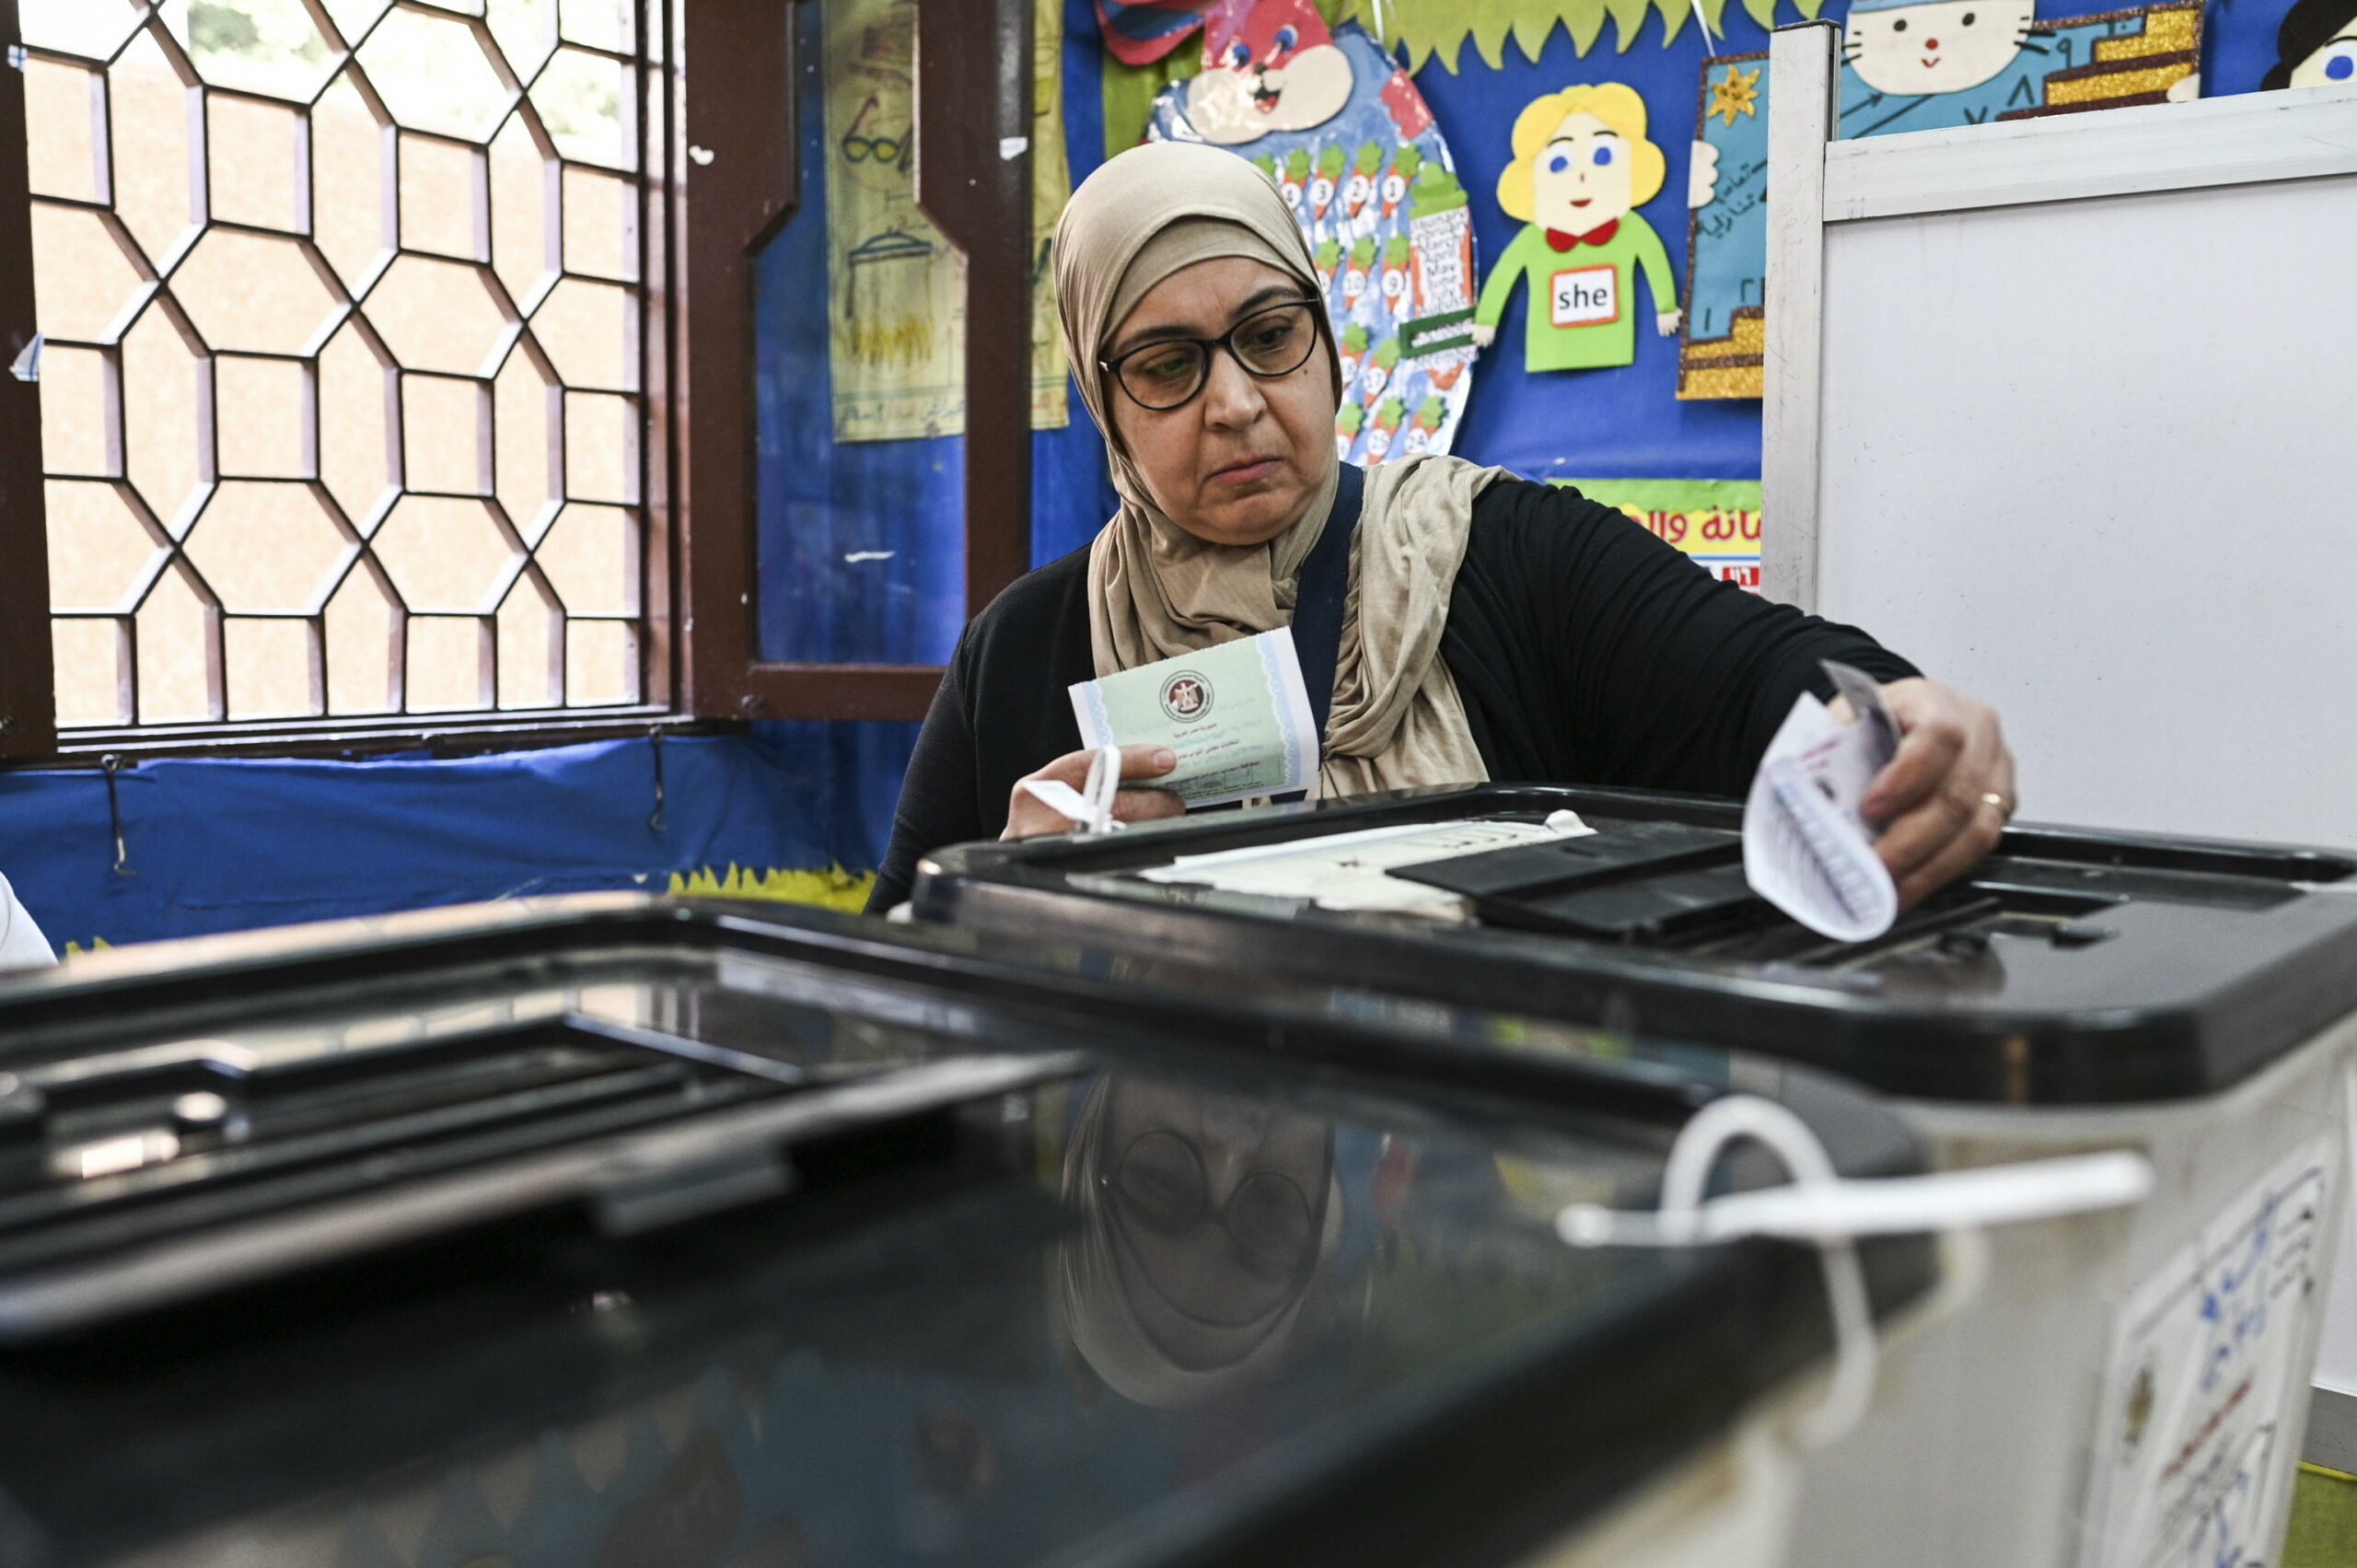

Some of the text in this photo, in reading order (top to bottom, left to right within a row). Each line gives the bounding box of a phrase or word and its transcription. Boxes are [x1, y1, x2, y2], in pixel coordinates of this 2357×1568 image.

[1318, 183, 1328, 200] 3
[1351, 180, 1363, 197] 2
[1388, 181, 1398, 198] 1
[1388, 276, 1399, 293] 9
[1559, 284, 1608, 310] she
[1629, 505, 1760, 543] انة وال
